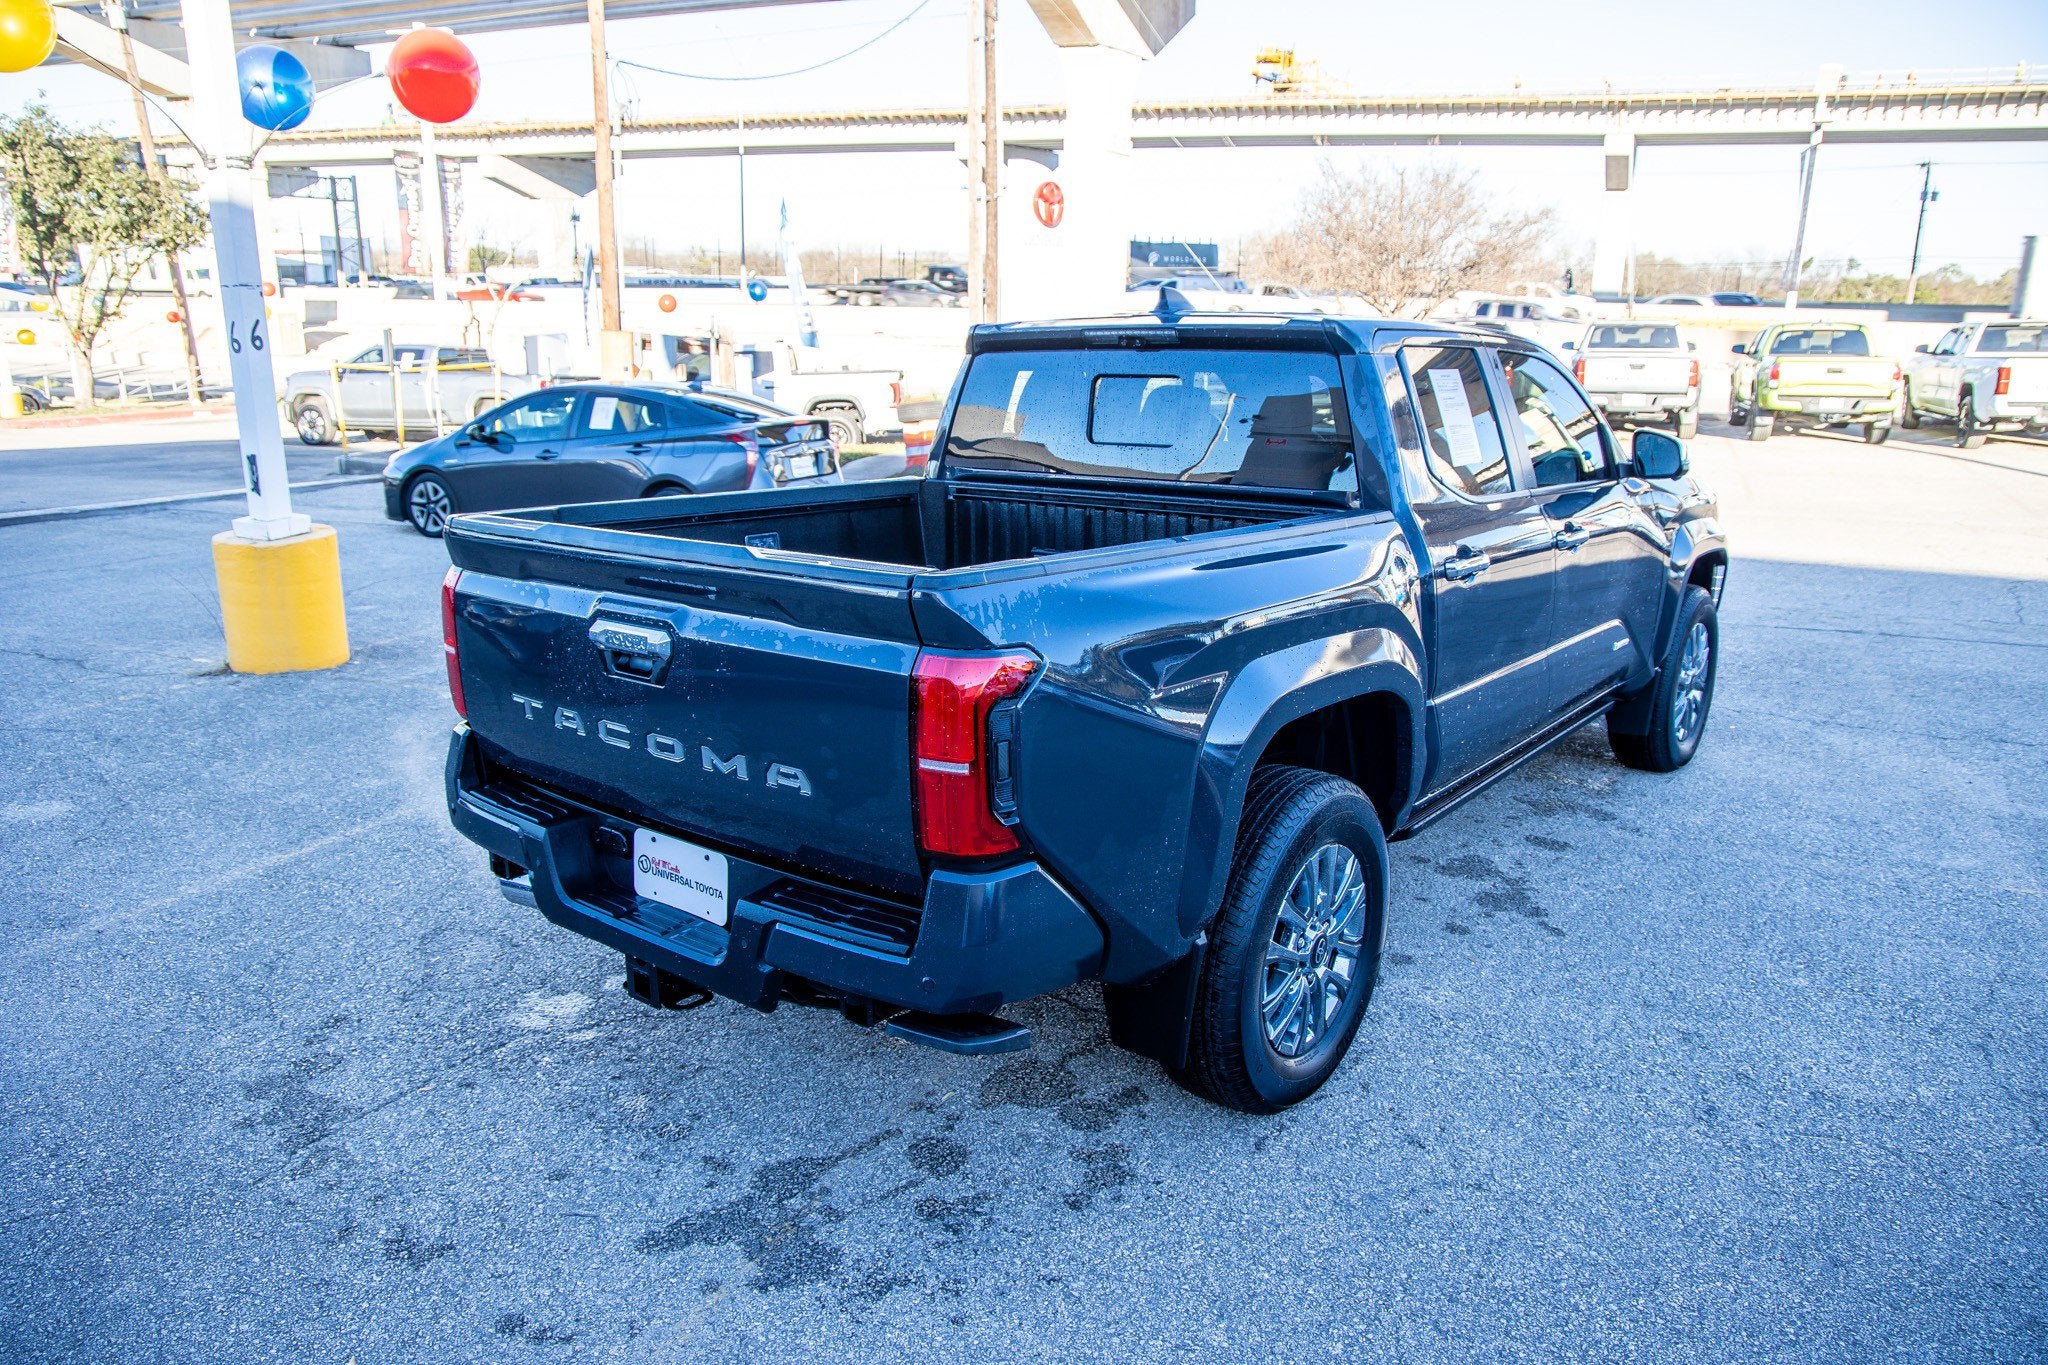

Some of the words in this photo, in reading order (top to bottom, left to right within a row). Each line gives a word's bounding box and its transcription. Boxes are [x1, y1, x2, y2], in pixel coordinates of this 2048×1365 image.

[1163, 255, 1207, 263] WORLD-R
[511, 693, 812, 797] TACOMA
[651, 866, 694, 889] UNIVERSAL
[694, 881, 724, 901] TOYOTA
